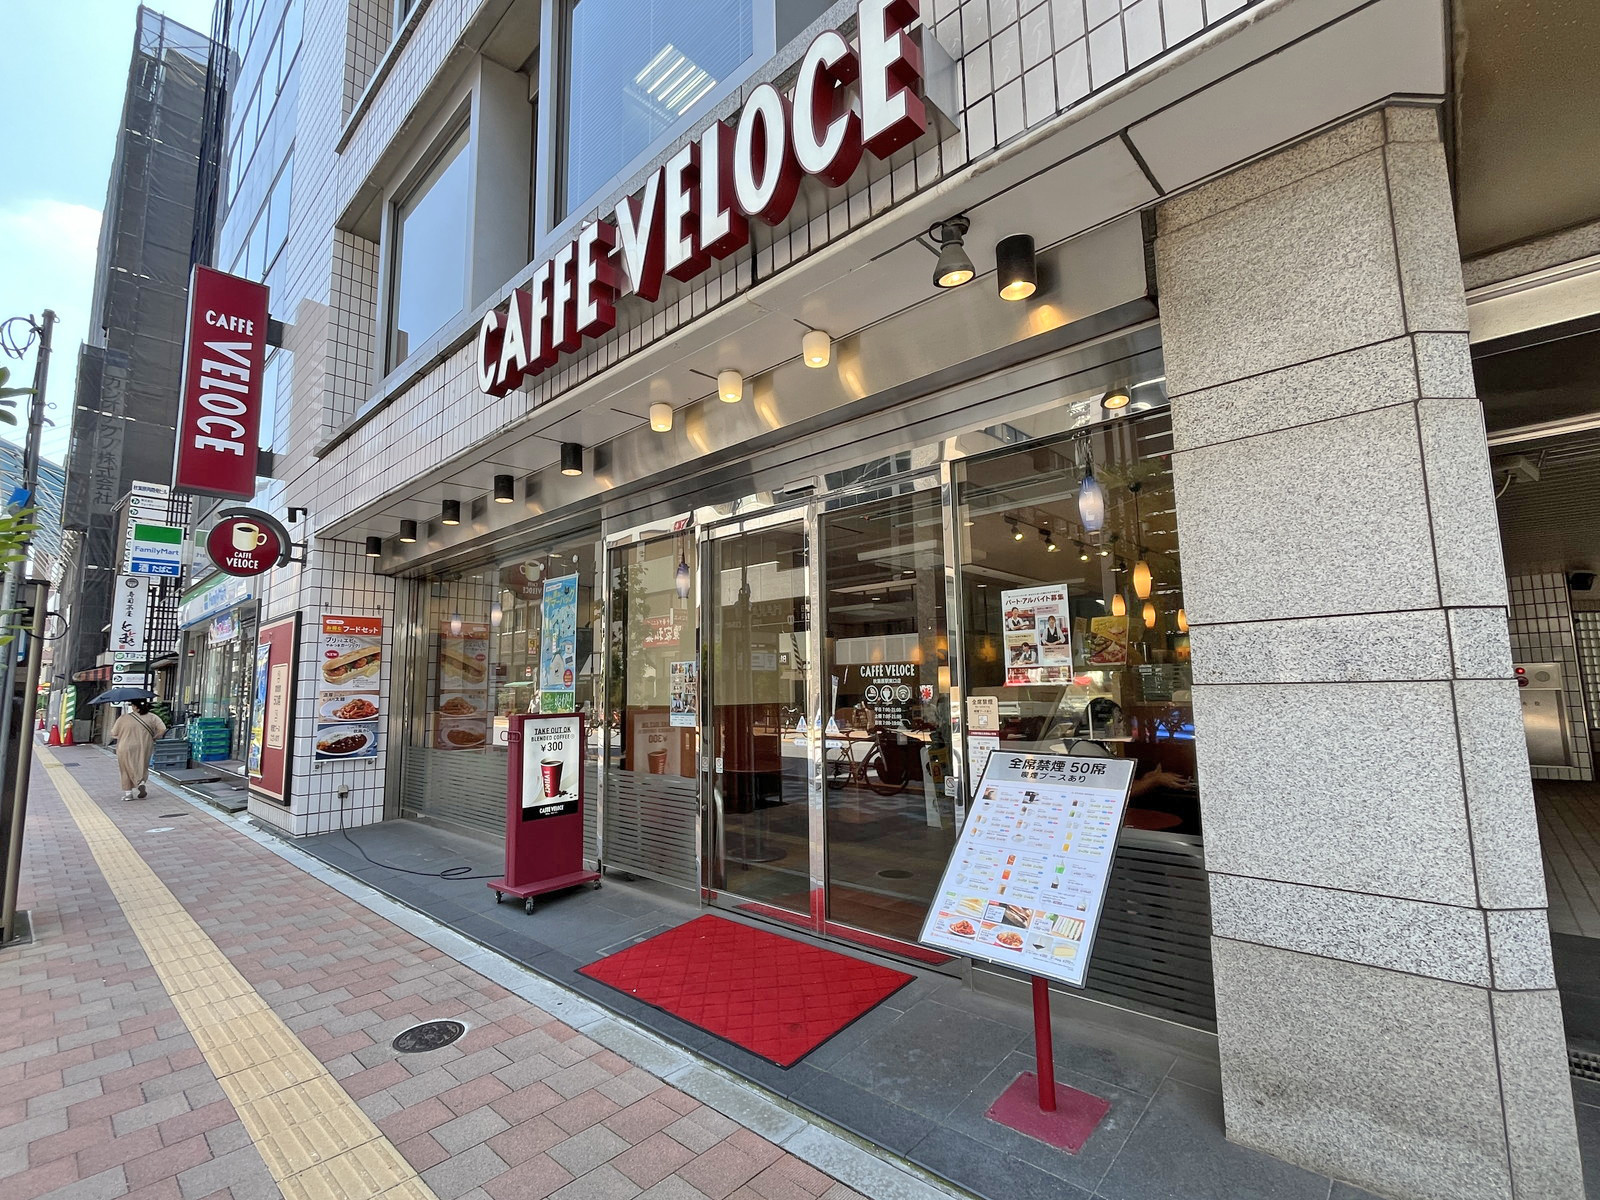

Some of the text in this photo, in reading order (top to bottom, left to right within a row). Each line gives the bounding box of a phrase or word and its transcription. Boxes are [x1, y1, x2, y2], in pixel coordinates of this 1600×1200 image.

[614, 0, 914, 295] VELOCE
[194, 341, 253, 456] VELOCE
[134, 545, 179, 556] FamilyMart
[226, 557, 259, 569] VELOCE
[151, 565, 173, 574] たばこ
[343, 626, 379, 634] フードセット
[884, 663, 915, 677] VELOCE
[534, 726, 572, 736] TAKE OUT OK
[531, 733, 570, 743] BLENDED COFFEE
[540, 741, 563, 752] ¥300
[1008, 757, 1067, 773] 全席禁煙
[1069, 762, 1108, 775] 50席
[1020, 771, 1087, 783] 喫煙ブースあり
